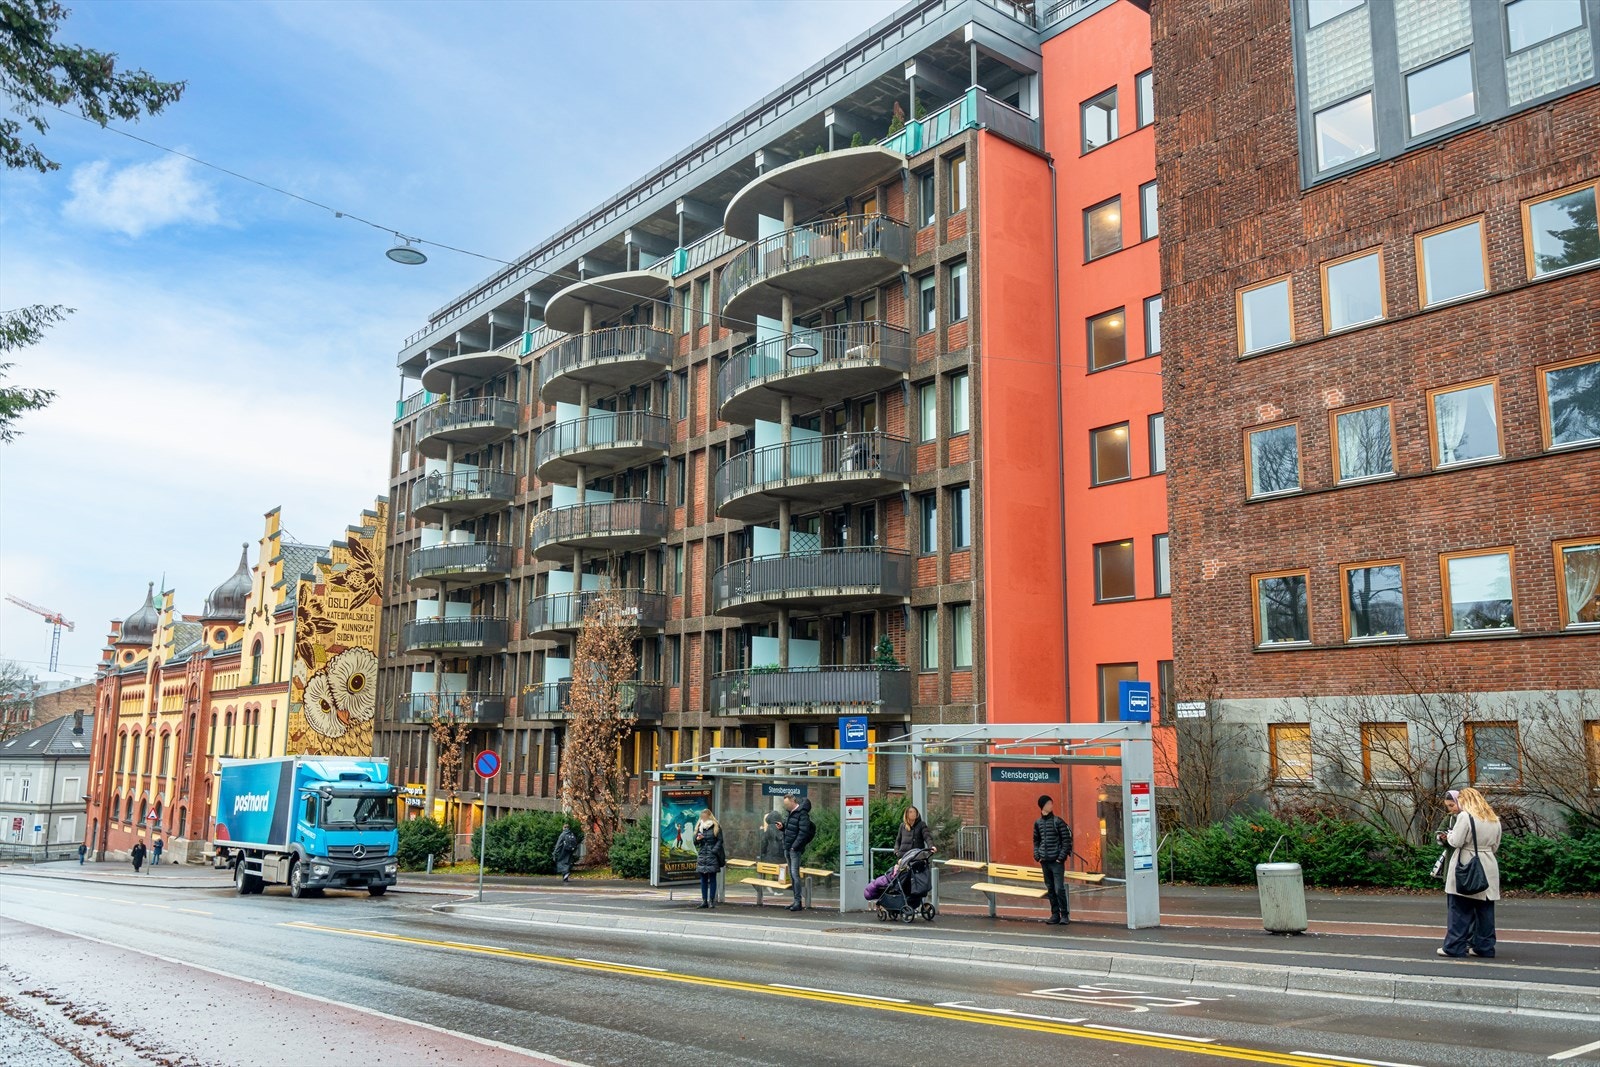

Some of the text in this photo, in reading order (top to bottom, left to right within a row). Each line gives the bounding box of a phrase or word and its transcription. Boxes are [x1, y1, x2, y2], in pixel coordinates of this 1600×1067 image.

[328, 597, 349, 609] OSLO
[326, 611, 374, 622] KATEDRALSKOLE
[341, 623, 373, 633] KUNNSKAP
[337, 632, 373, 646] SIDEN 1153
[1000, 770, 1049, 781] Stensberggata
[233, 790, 270, 815] postnord
